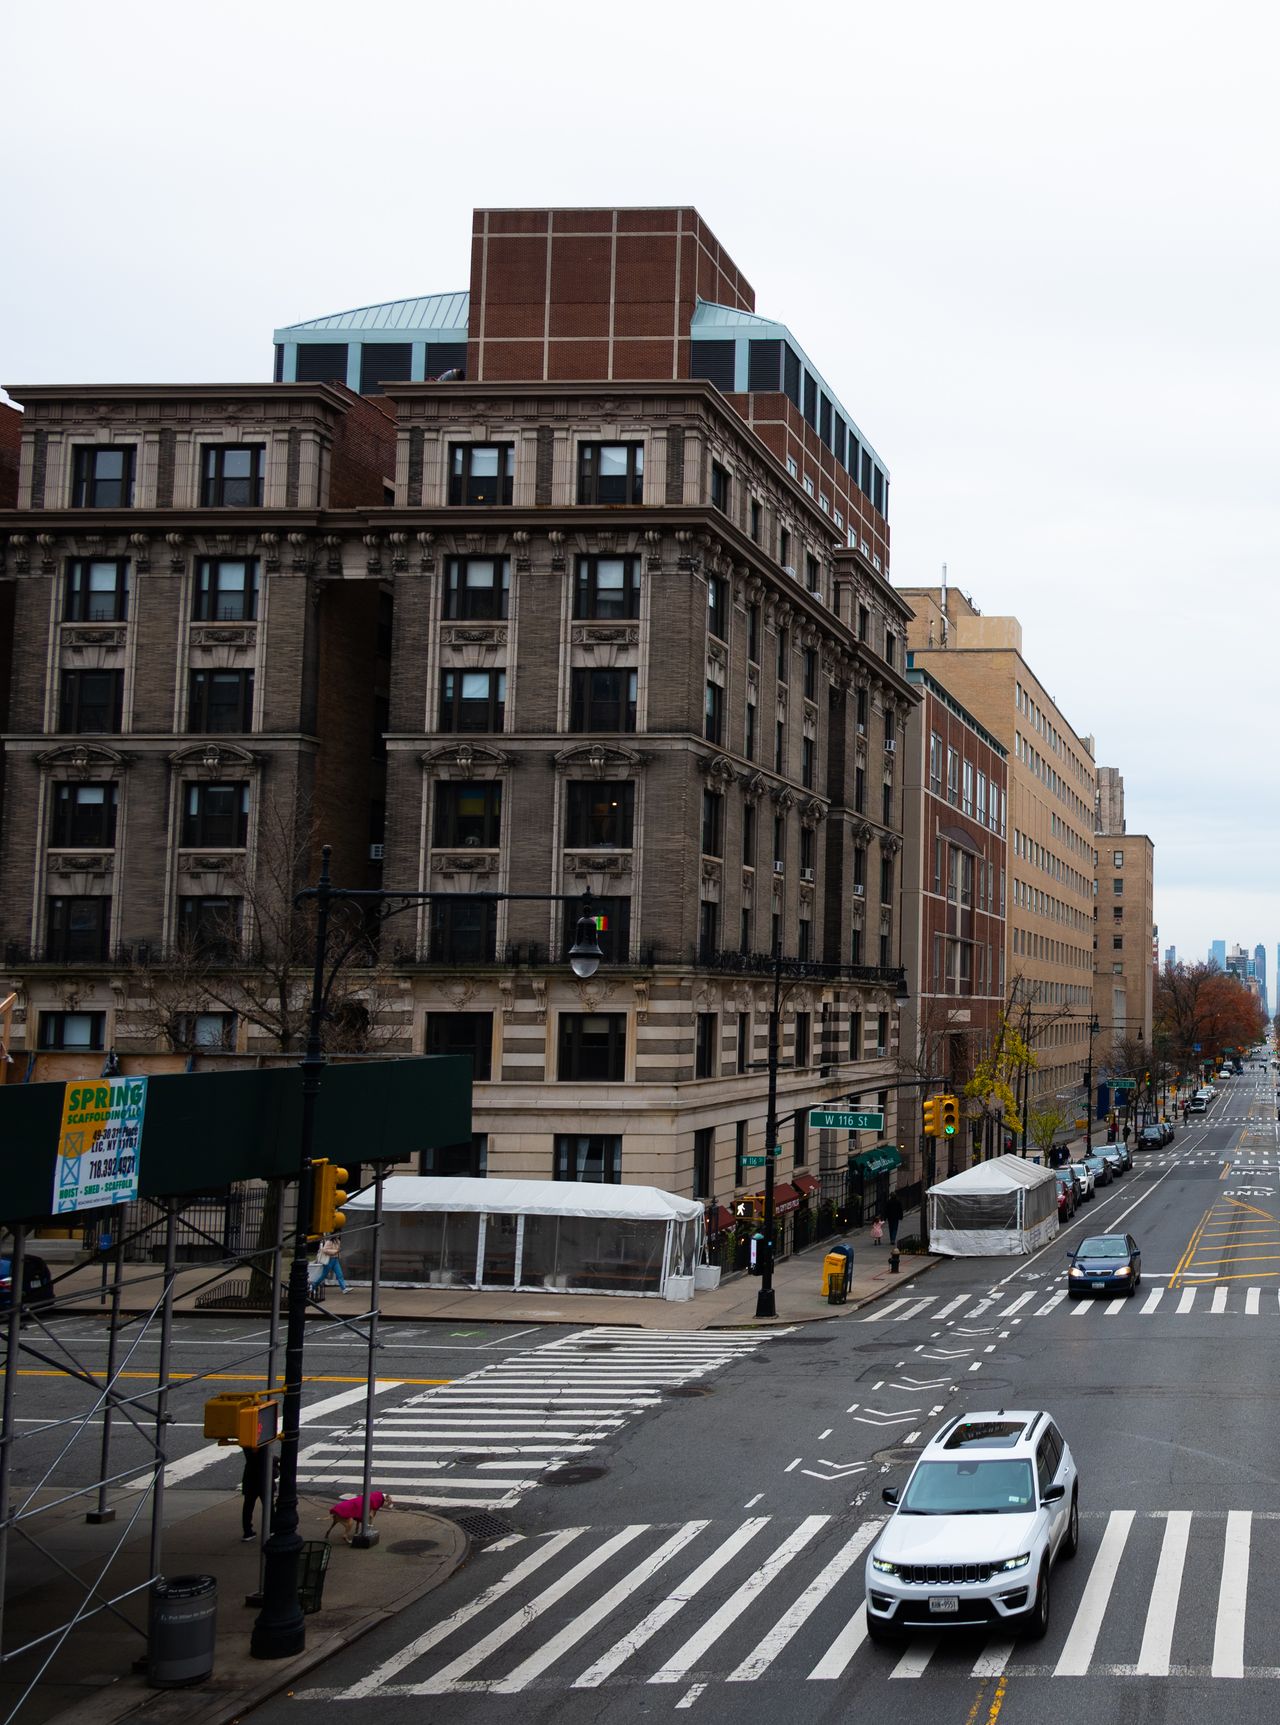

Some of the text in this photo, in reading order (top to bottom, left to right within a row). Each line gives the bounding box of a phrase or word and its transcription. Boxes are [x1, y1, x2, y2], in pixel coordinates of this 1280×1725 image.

[69, 1084, 142, 1111] SPRING
[67, 1110, 126, 1124] SCAFFOLDING
[825, 1115, 868, 1126] W 116 St
[107, 1140, 116, 1150] NY
[89, 1156, 136, 1180] 718.392.4921
[59, 1179, 132, 1199] HOIST SHED SCAFFOLD
